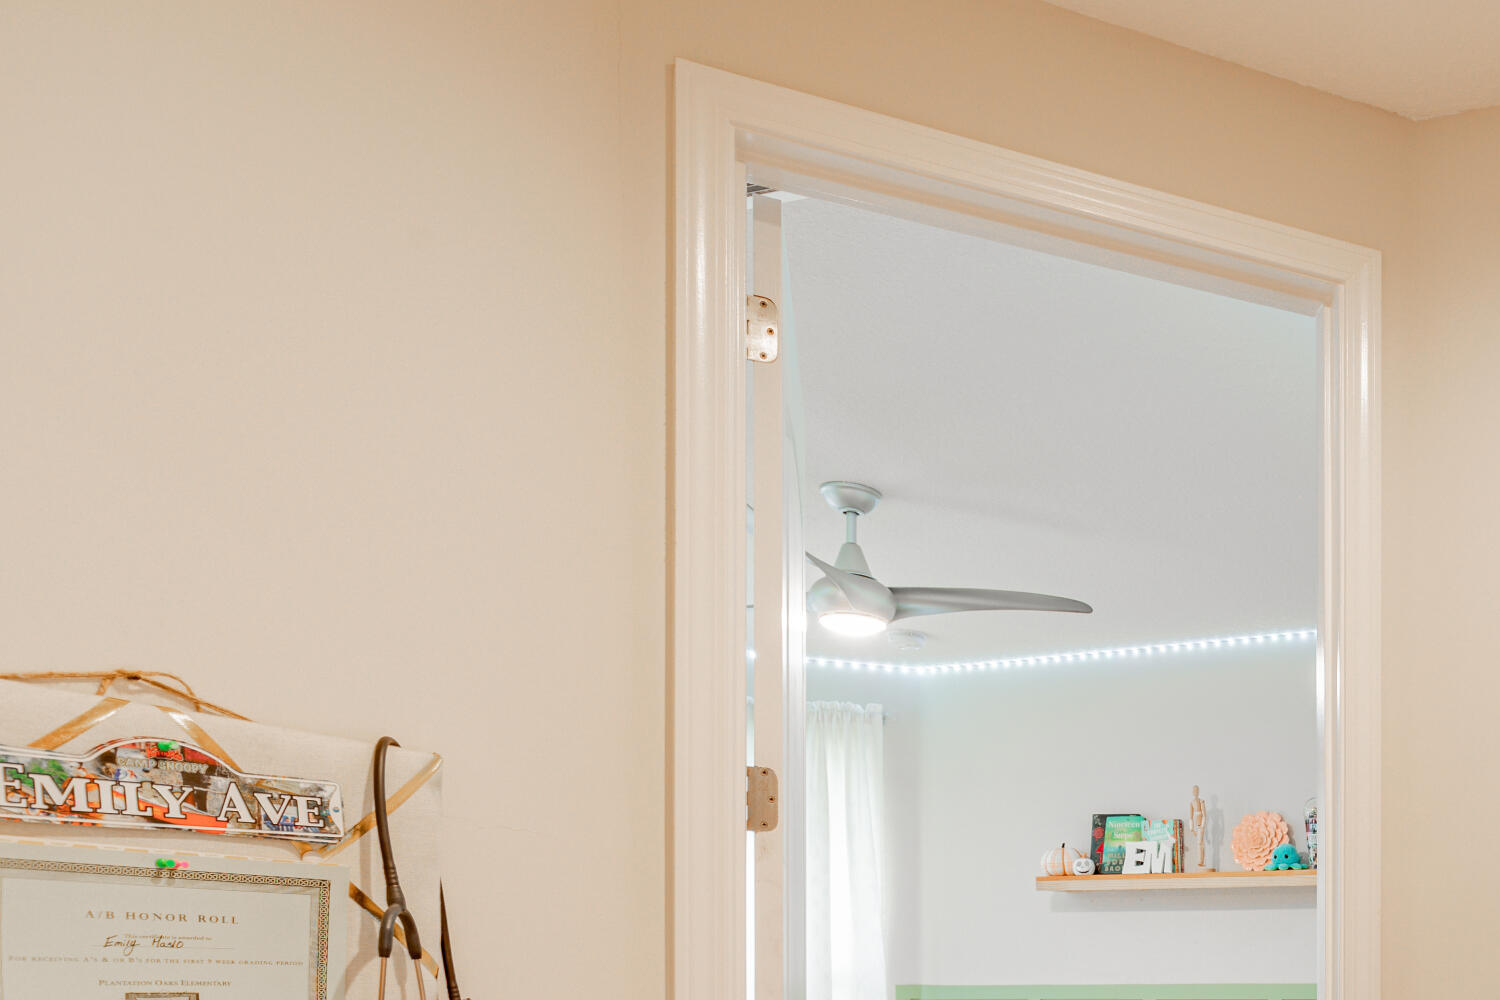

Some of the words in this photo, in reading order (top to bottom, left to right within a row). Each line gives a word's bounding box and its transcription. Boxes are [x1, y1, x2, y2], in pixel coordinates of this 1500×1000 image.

[118, 757, 157, 770] CAMP
[159, 760, 209, 775] SNOOPY
[0, 762, 194, 819] EMILY
[217, 782, 325, 828] AVE
[86, 910, 115, 921] A/B
[125, 911, 187, 922] HONOR
[198, 914, 239, 925] ROLL
[103, 935, 140, 956] Emily
[180, 979, 232, 987] ELEMENTARY
